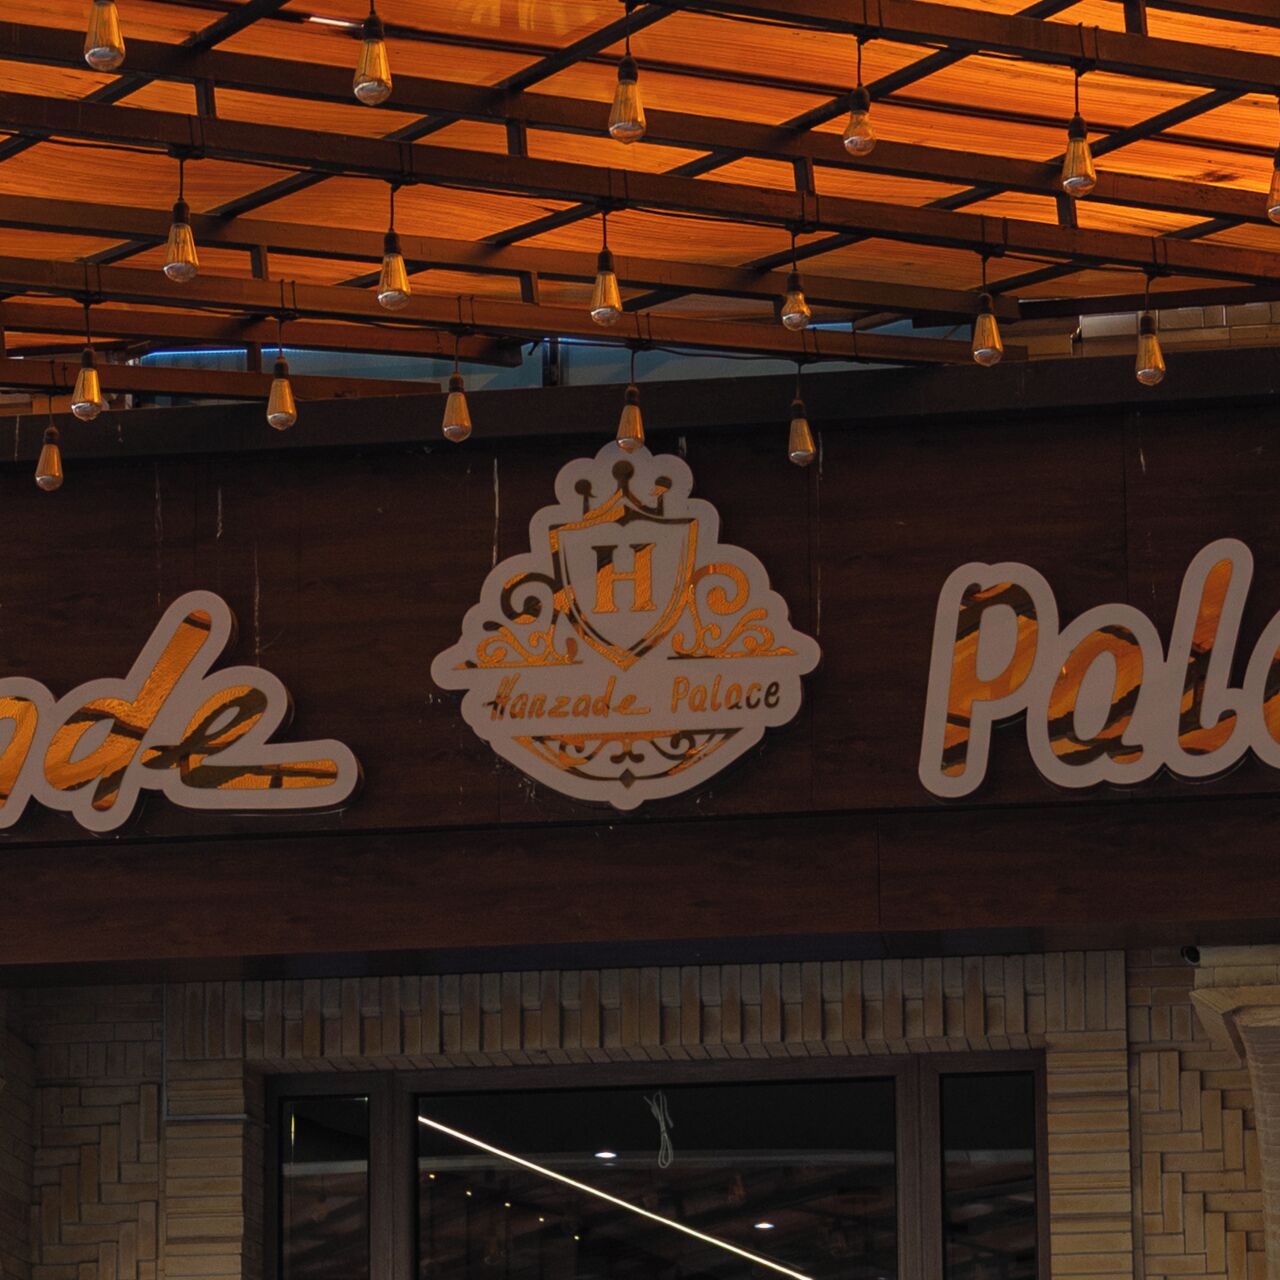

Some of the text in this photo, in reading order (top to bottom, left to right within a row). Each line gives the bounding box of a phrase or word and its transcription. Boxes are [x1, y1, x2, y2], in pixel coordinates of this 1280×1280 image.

[590, 543, 657, 614] H
[484, 675, 780, 721] Hanzade Palace
